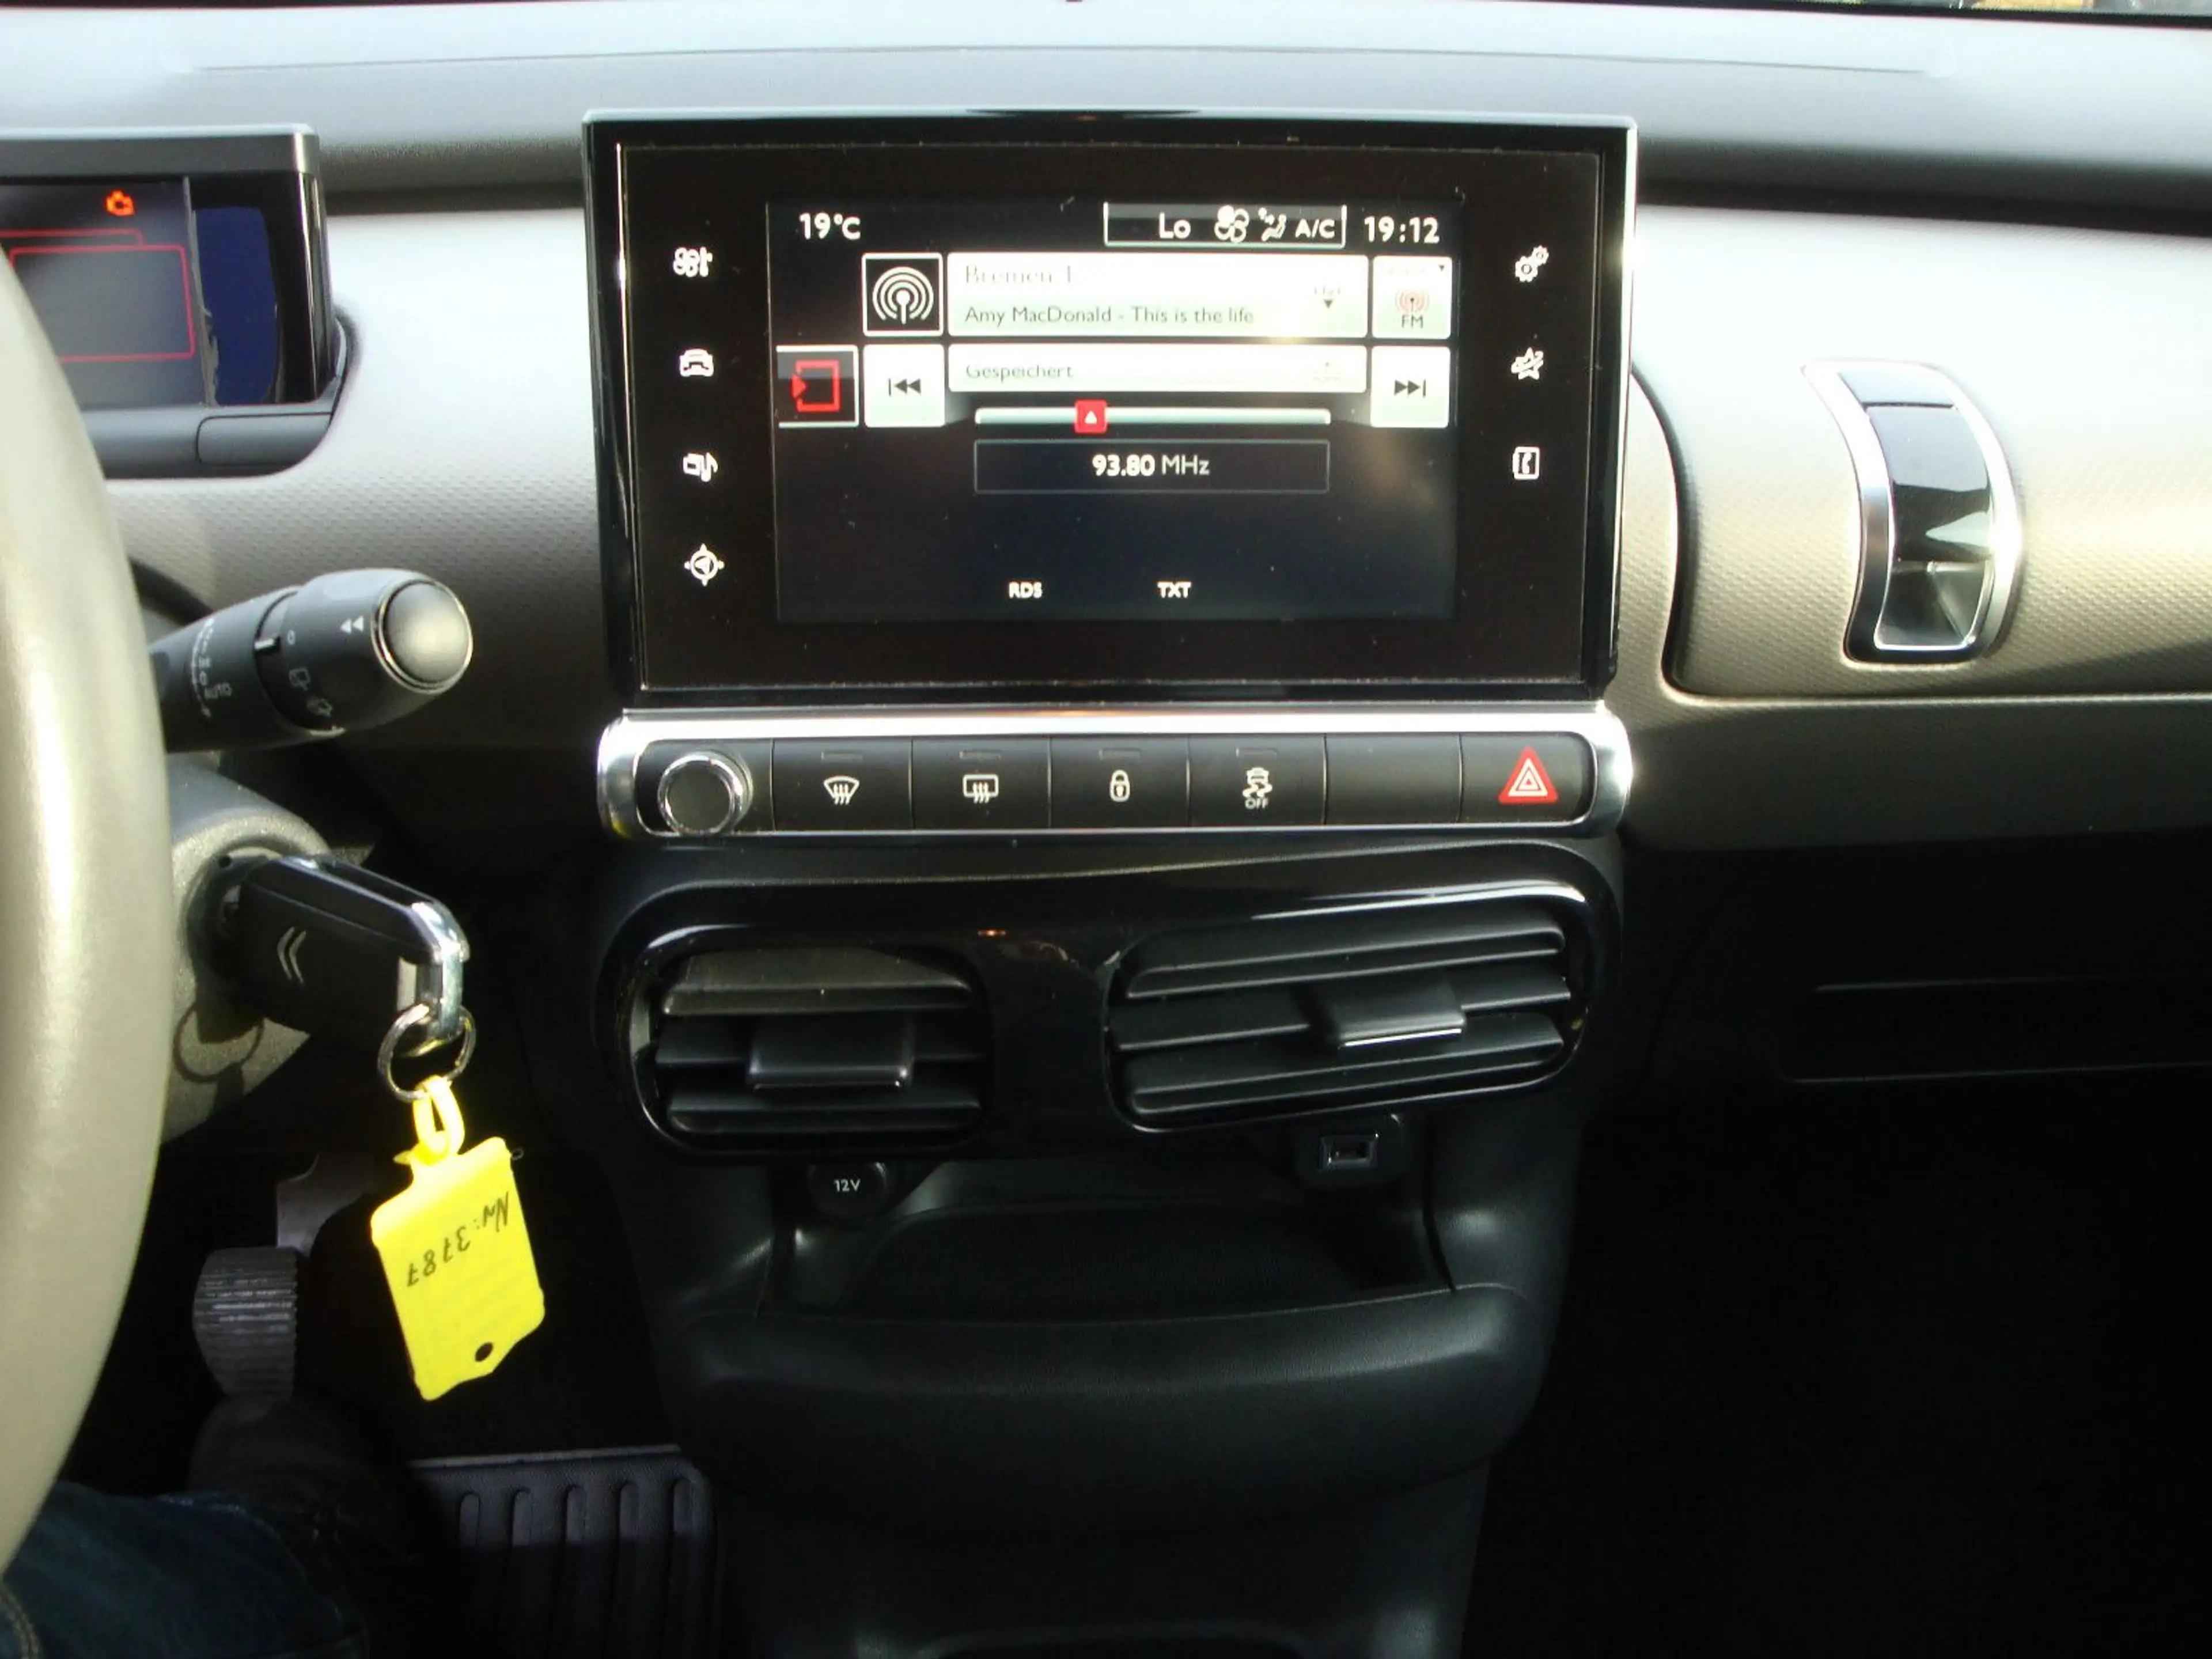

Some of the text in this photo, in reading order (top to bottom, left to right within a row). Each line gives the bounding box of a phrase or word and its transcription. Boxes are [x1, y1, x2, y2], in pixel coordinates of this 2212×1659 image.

[799, 212, 861, 240] 19°C
[1158, 212, 1191, 239] Lo
[1295, 219, 1335, 239] A/C
[1363, 216, 1440, 243] 19:12
[965, 306, 1005, 328] Amy
[1012, 306, 1112, 324] MacDonald
[1131, 306, 1168, 324] This
[1175, 307, 1187, 323] is
[1194, 307, 1222, 324] the
[1229, 306, 1255, 324] life
[1401, 315, 1423, 328] FM
[965, 364, 1074, 384] Gespeichert
[1092, 454, 1210, 477] 93.80 MHz
[1009, 582, 1043, 598] RDS
[1157, 581, 1191, 598] TXT
[1244, 797, 1268, 810] OFF
[834, 1179, 861, 1192] 12V
[407, 1226, 471, 1287] 3787
